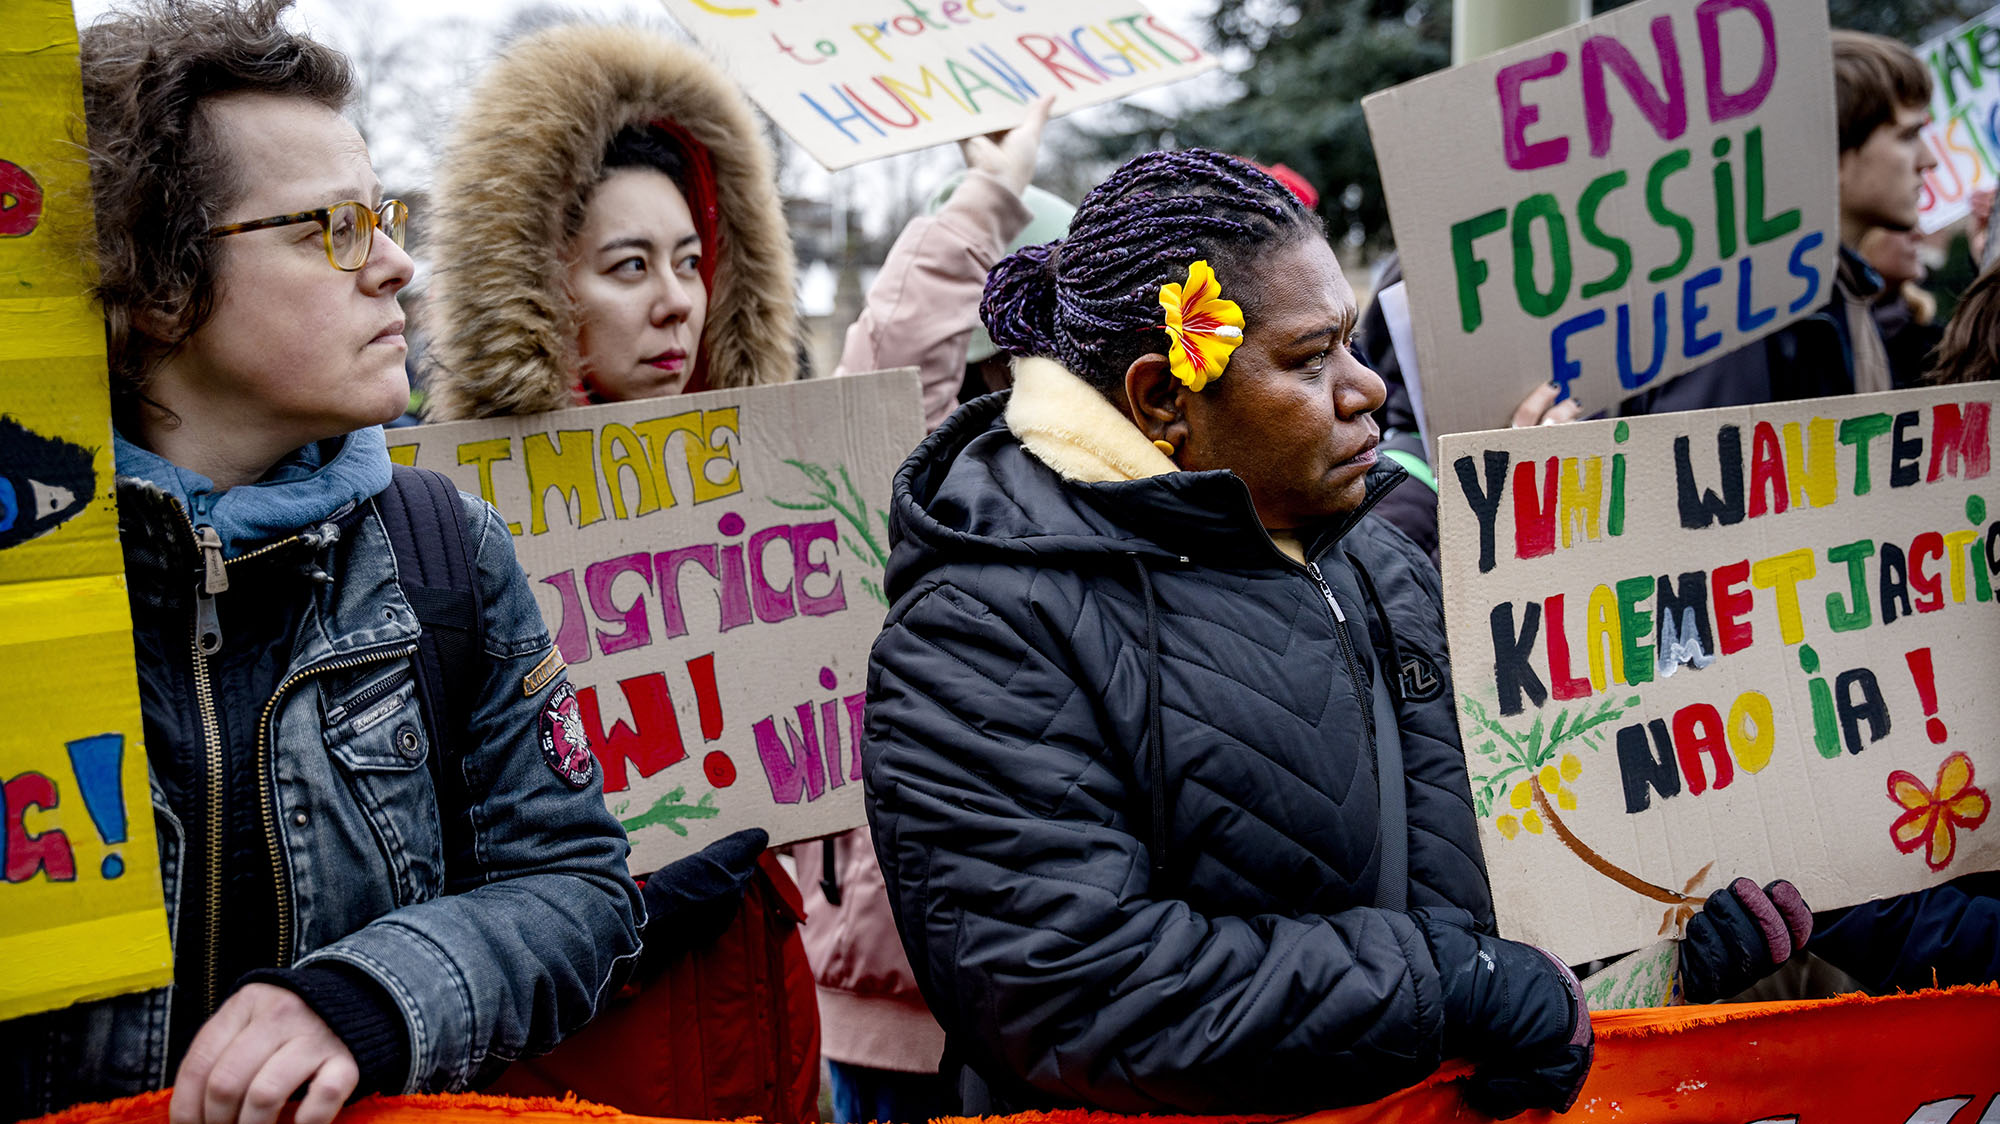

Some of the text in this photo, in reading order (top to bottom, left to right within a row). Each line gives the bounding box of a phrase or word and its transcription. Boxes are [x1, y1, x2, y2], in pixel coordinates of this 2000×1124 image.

[772, 33, 838, 66] to
[800, 14, 1204, 145] HUMAN RIGHTS
[1496, 0, 1778, 171] END
[1551, 231, 1824, 405] FUELS
[388, 405, 744, 536] IMATE
[1673, 401, 1992, 529] WANTEM
[1490, 547, 1816, 716] KLAEMET
[1616, 689, 1775, 814] NAO
